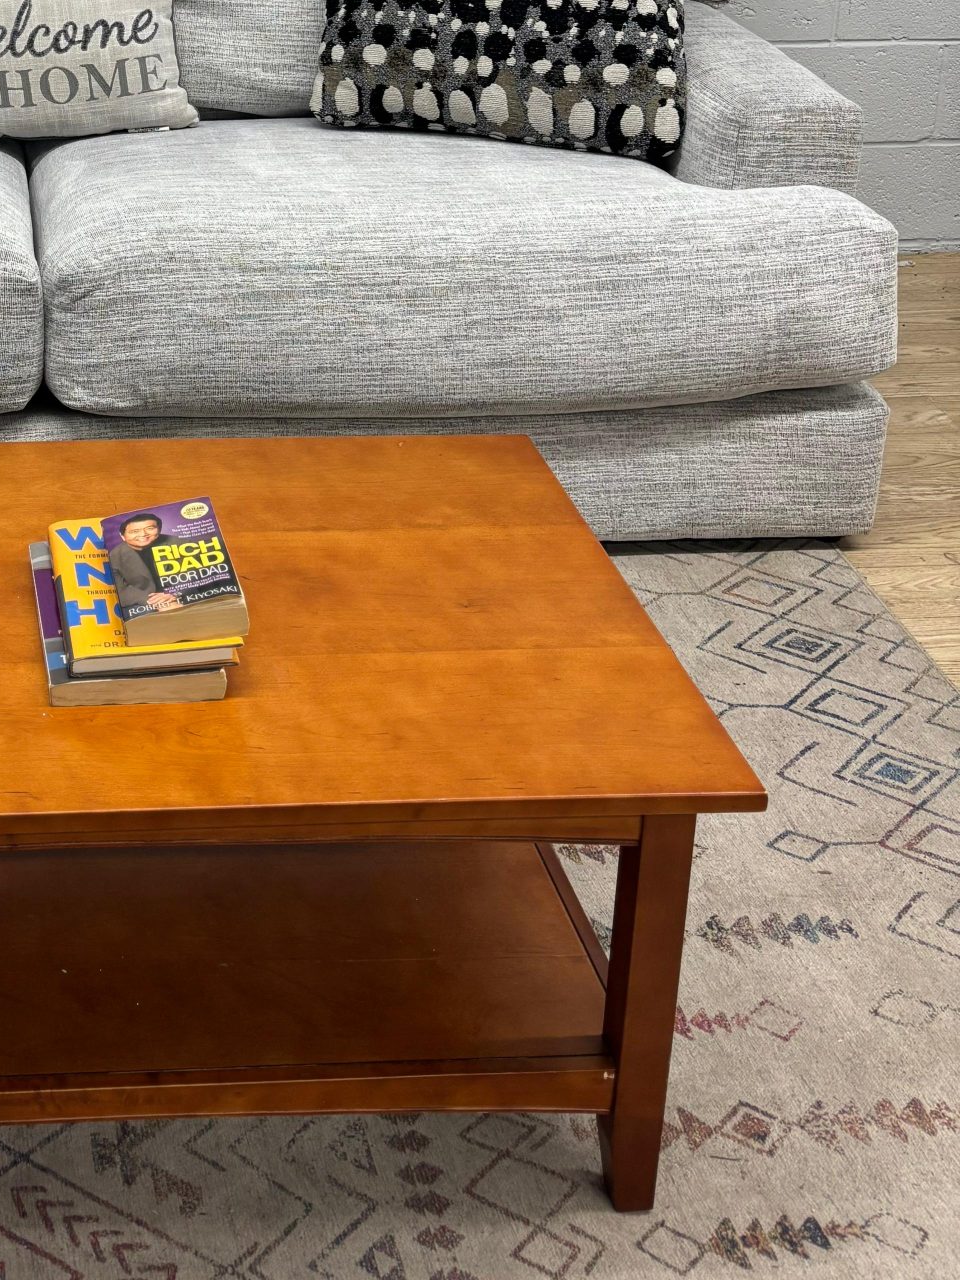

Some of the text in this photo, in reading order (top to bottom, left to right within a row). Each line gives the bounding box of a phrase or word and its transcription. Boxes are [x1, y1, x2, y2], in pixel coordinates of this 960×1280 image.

[152, 536, 221, 561] RICH
[156, 551, 225, 576] DAD
[160, 570, 198, 587] POOR
[199, 563, 229, 578] DAD
[128, 601, 171, 617] ROBERT
[186, 585, 238, 602] KIYOSAKI
